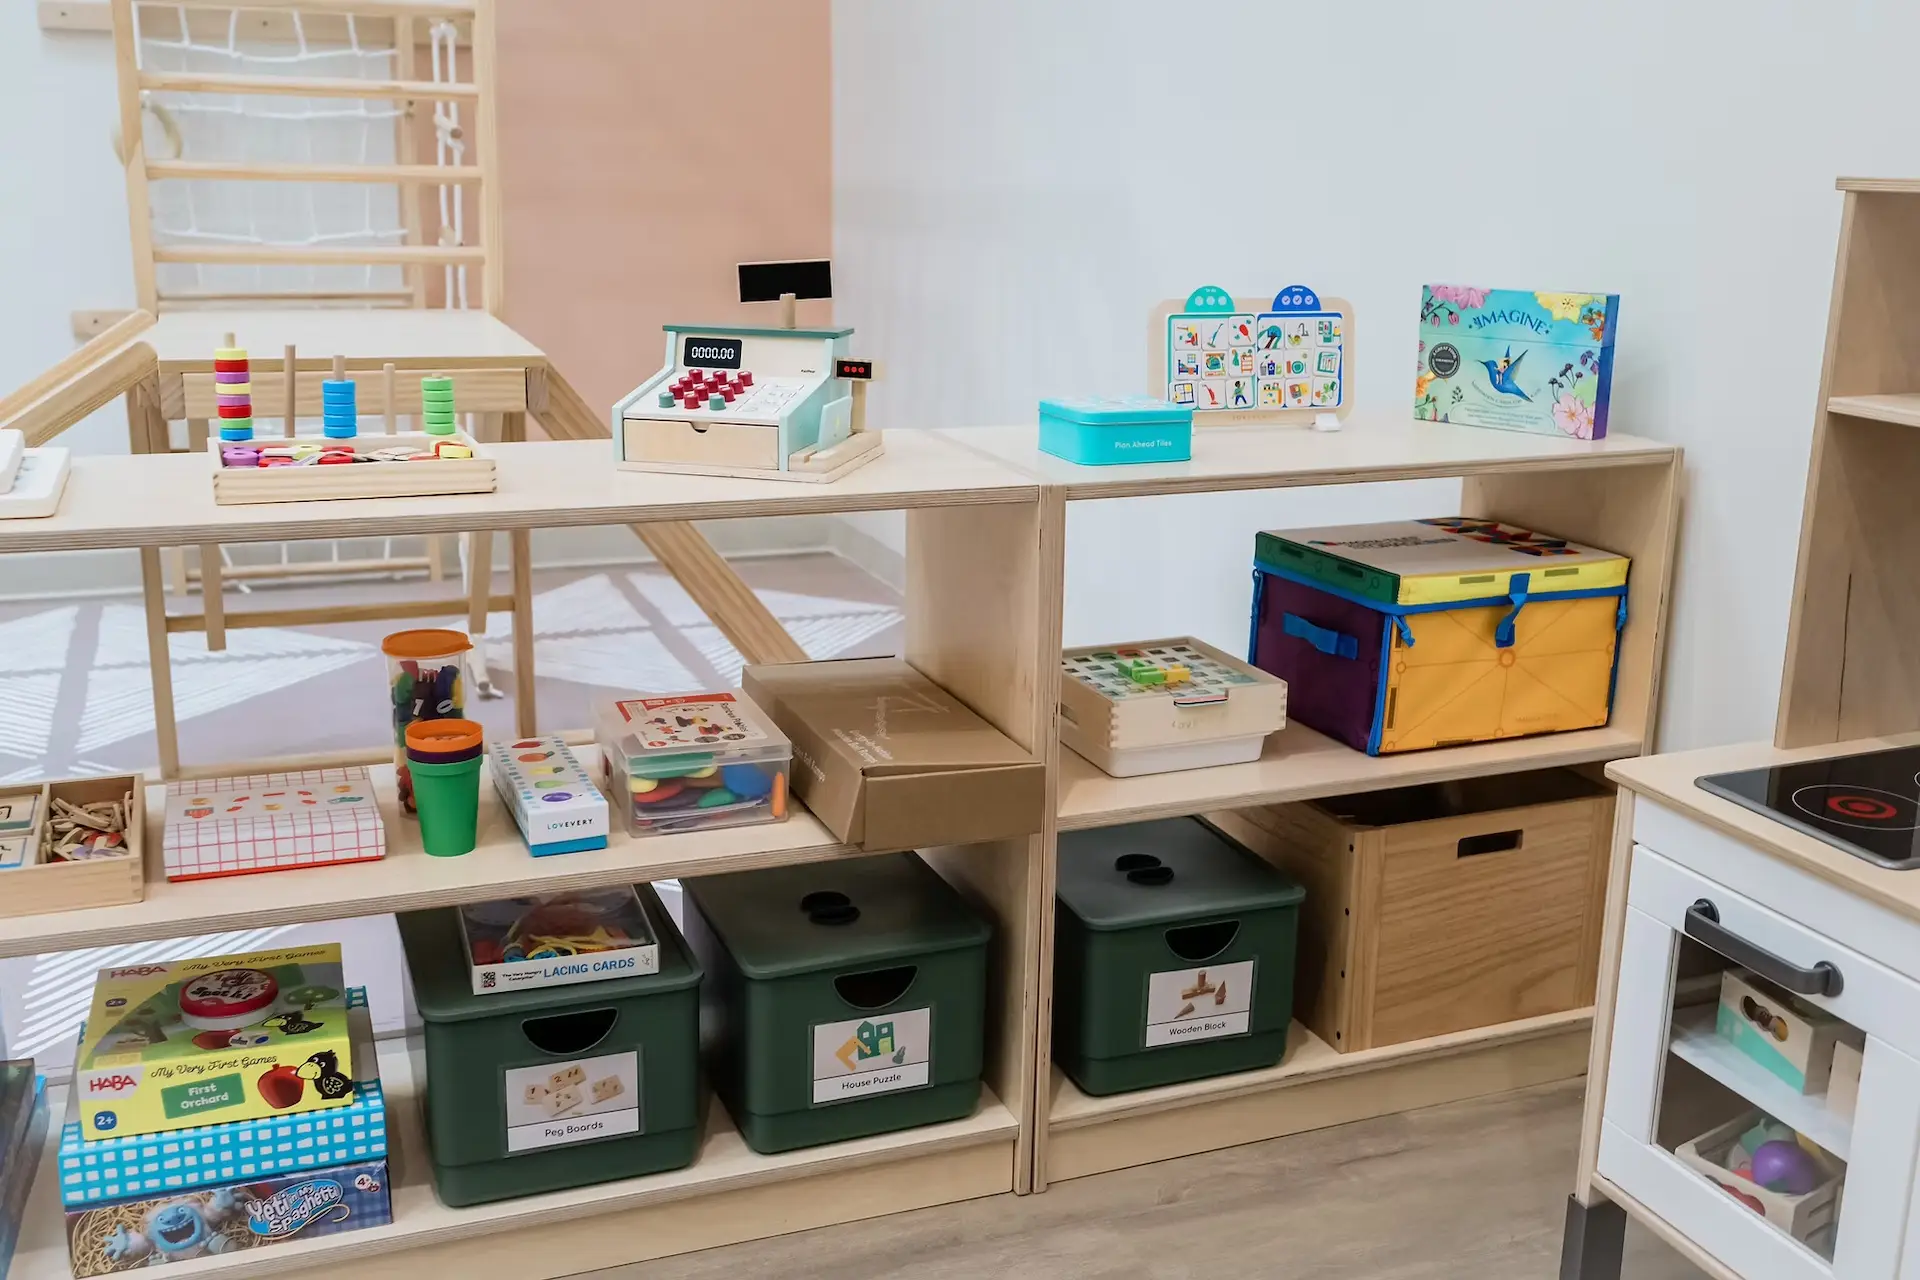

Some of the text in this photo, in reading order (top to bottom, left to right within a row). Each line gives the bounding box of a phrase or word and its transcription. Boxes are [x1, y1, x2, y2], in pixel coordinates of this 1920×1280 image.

[1472, 309, 1547, 335] IMAGINE
[691, 346, 735, 360] 0000.00
[1115, 439, 1172, 449] Plan Ahead Tiles
[547, 818, 593, 830] LOVEVERY
[182, 950, 327, 972] My Very First Games
[543, 963, 588, 978] LACING
[593, 957, 635, 972] CARDS
[111, 966, 168, 979] HABA
[1169, 1021, 1226, 1036] Wooden Block
[151, 1055, 277, 1079] My Very First Games
[90, 1075, 137, 1093] HABA
[188, 1083, 217, 1097] First
[842, 1074, 902, 1090] House Puzzle
[180, 1092, 229, 1110] Orchard
[97, 1115, 114, 1127] 2+
[545, 1121, 604, 1138] Peg Boards
[244, 1192, 290, 1222] Yeti
[269, 1184, 341, 1234] Spaghetti
